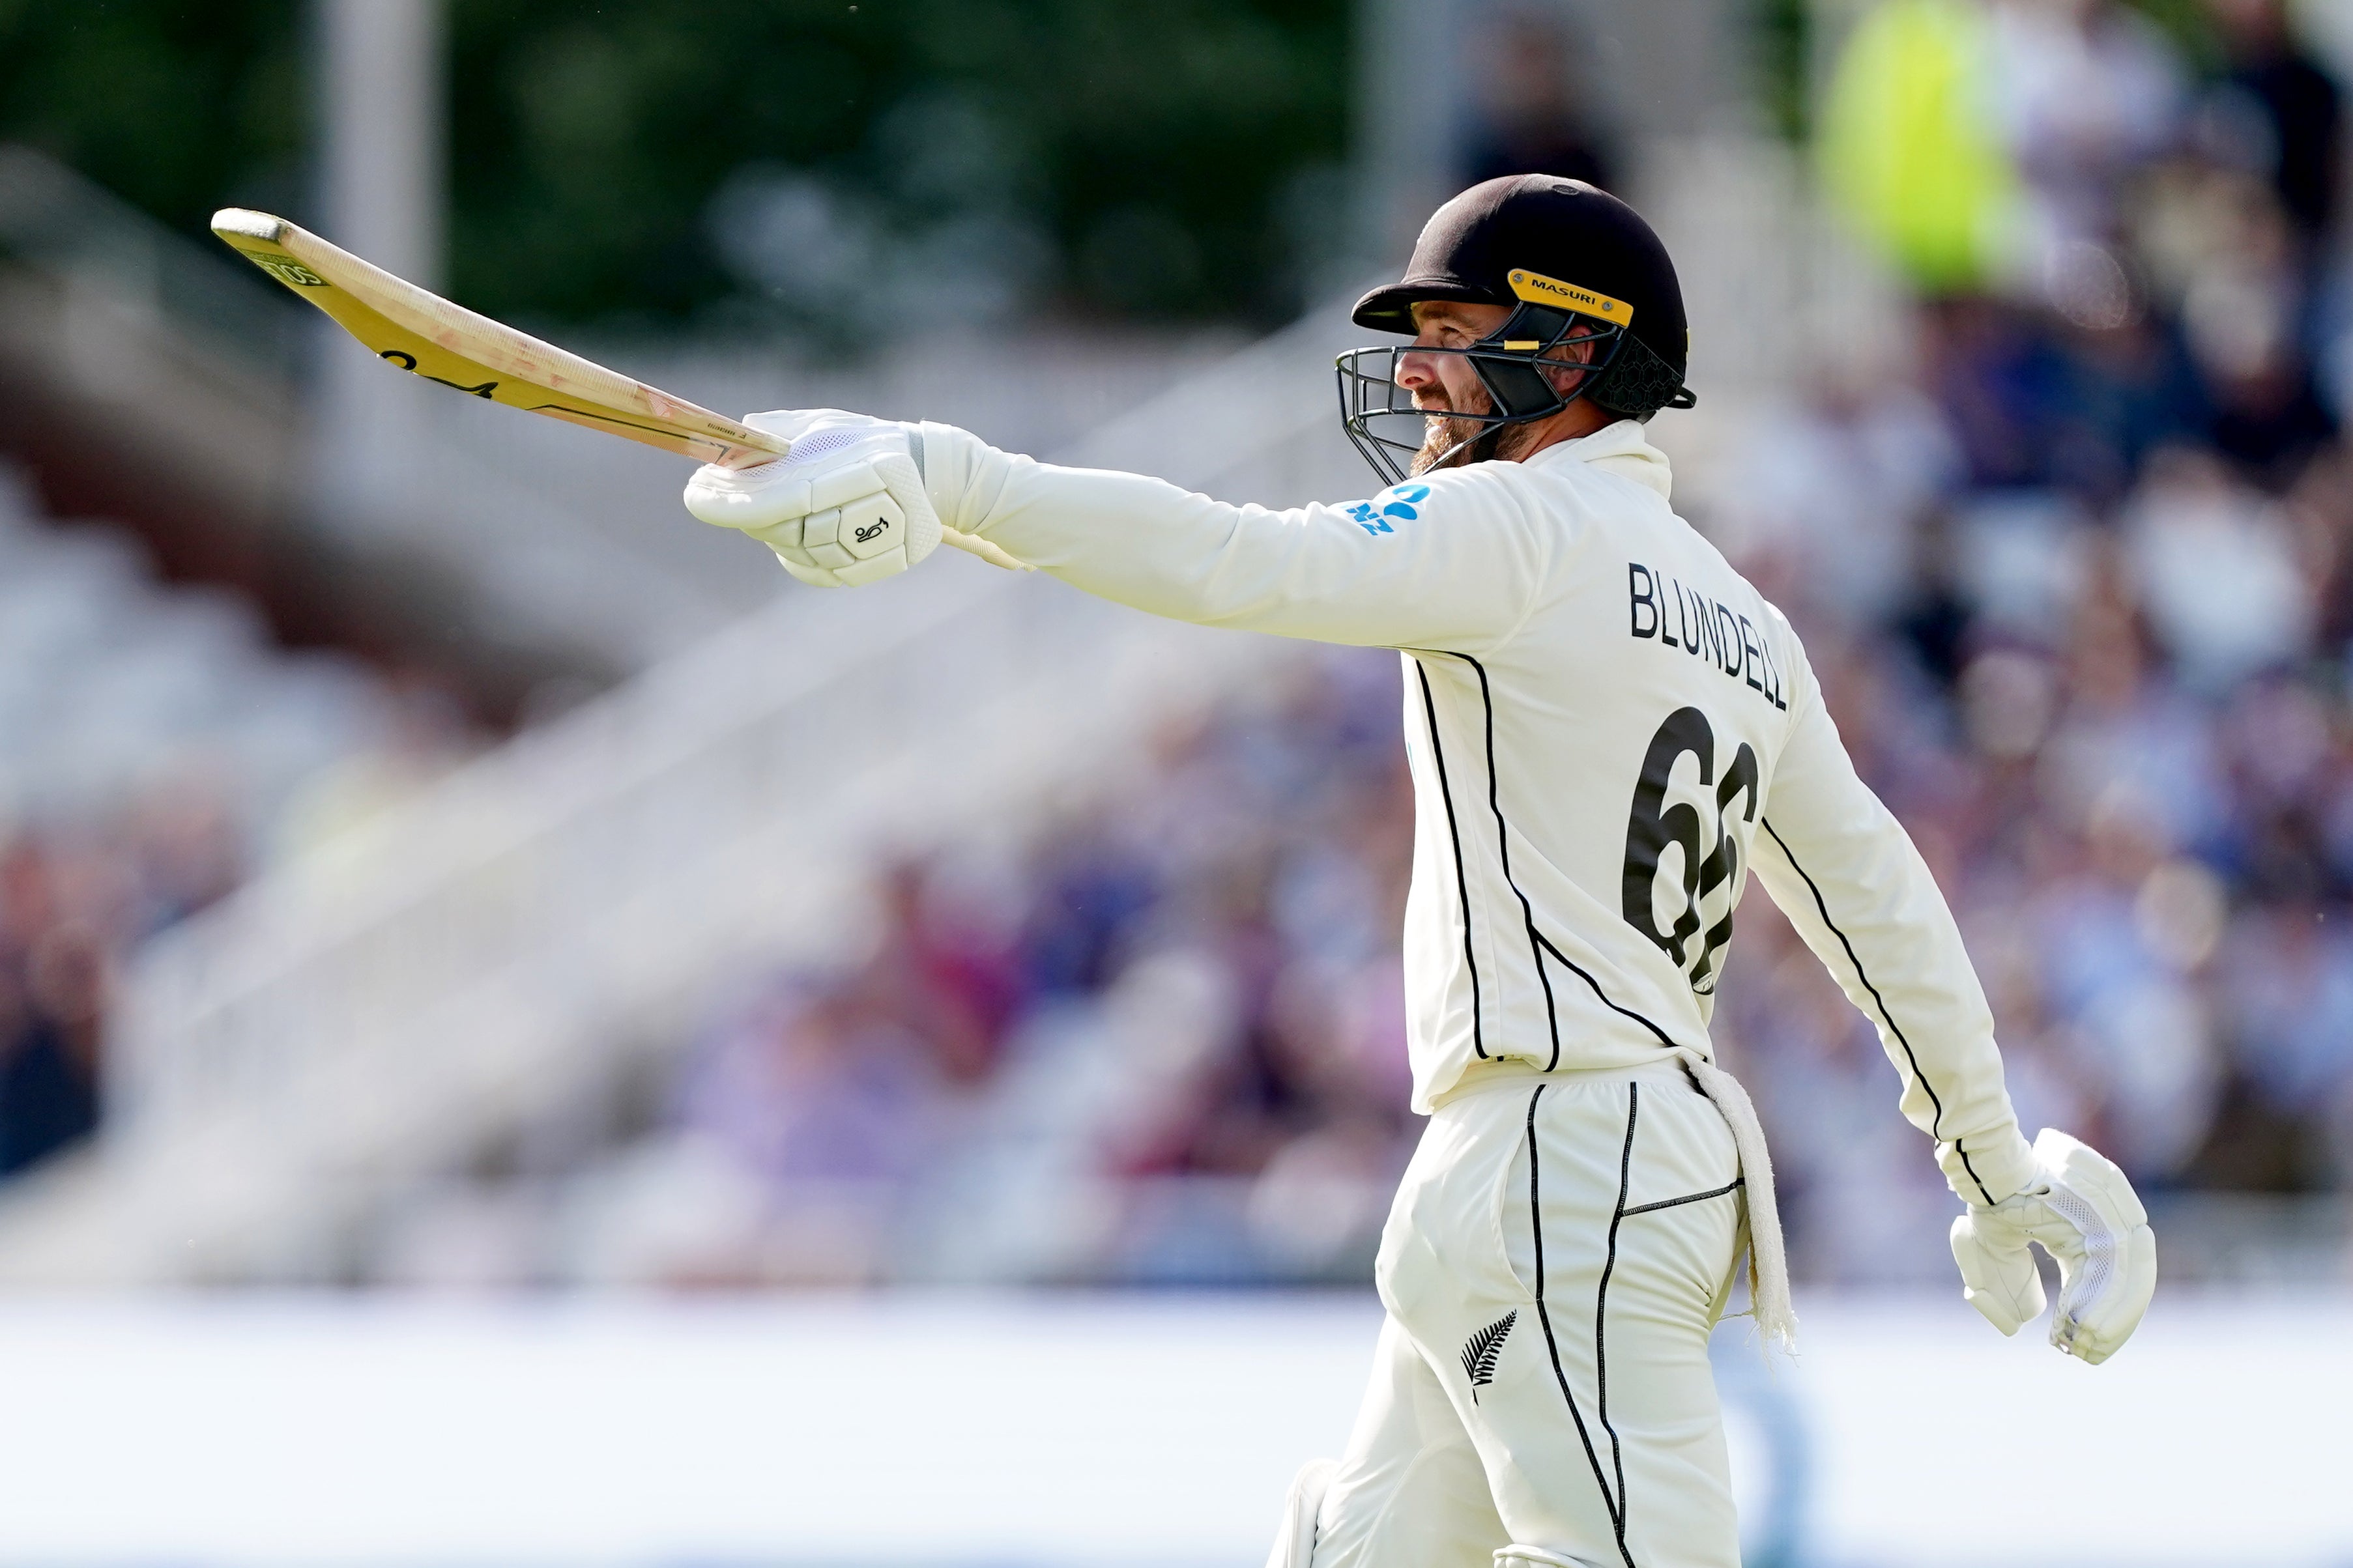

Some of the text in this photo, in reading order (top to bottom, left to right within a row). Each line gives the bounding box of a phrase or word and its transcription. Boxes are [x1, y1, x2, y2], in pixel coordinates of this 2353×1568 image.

[1531, 279, 1596, 305] MASURI
[1628, 562, 1787, 712] BLUNDELL
[1622, 706, 1759, 995] 66
